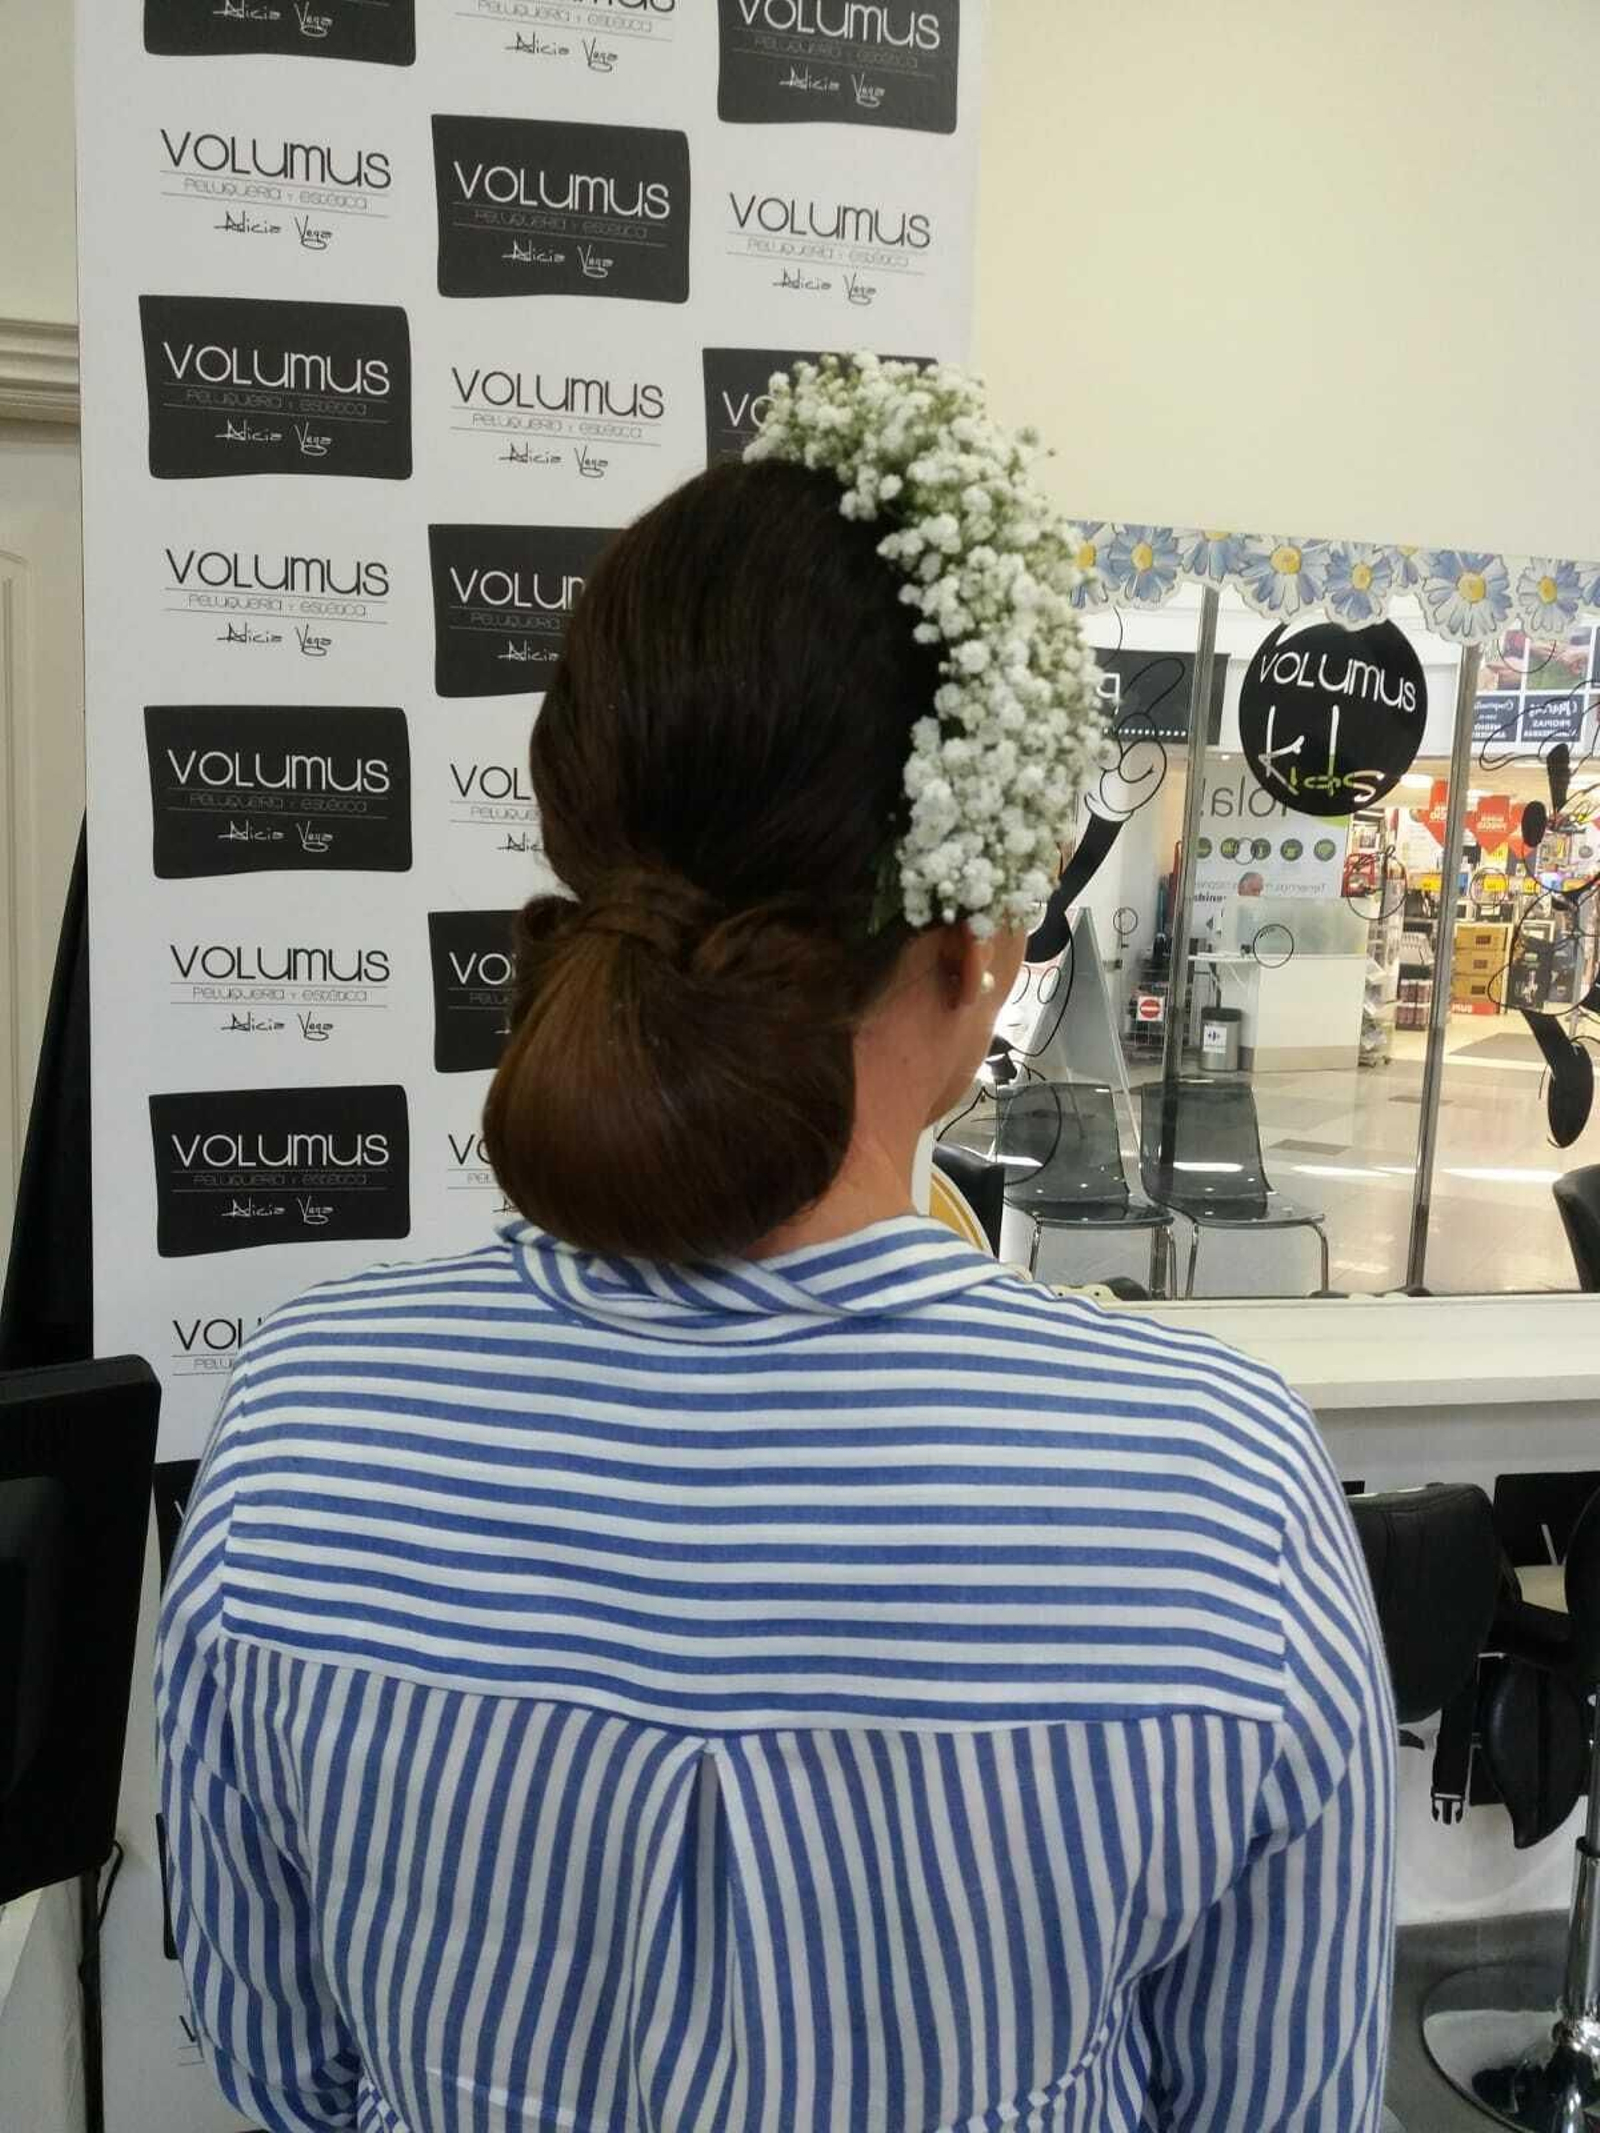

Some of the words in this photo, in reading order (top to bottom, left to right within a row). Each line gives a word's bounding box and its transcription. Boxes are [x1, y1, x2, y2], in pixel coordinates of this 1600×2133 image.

[739, 0, 940, 49] VOLUMUS
[160, 129, 392, 189] VOLUMUS
[454, 160, 671, 220] VOLUMUS
[729, 192, 931, 248] VOLUMUS
[163, 342, 390, 395] VOLUMUS
[452, 367, 664, 419] VOLUMUS
[165, 549, 390, 596] VOLUMUS
[1260, 652, 1417, 712] VOLUMUS
[167, 749, 390, 793] VOLUMUS
[497, 833, 543, 852] Alic
[170, 945, 390, 982] VOLUMUS
[172, 1134, 389, 1168] VOLUMUS
